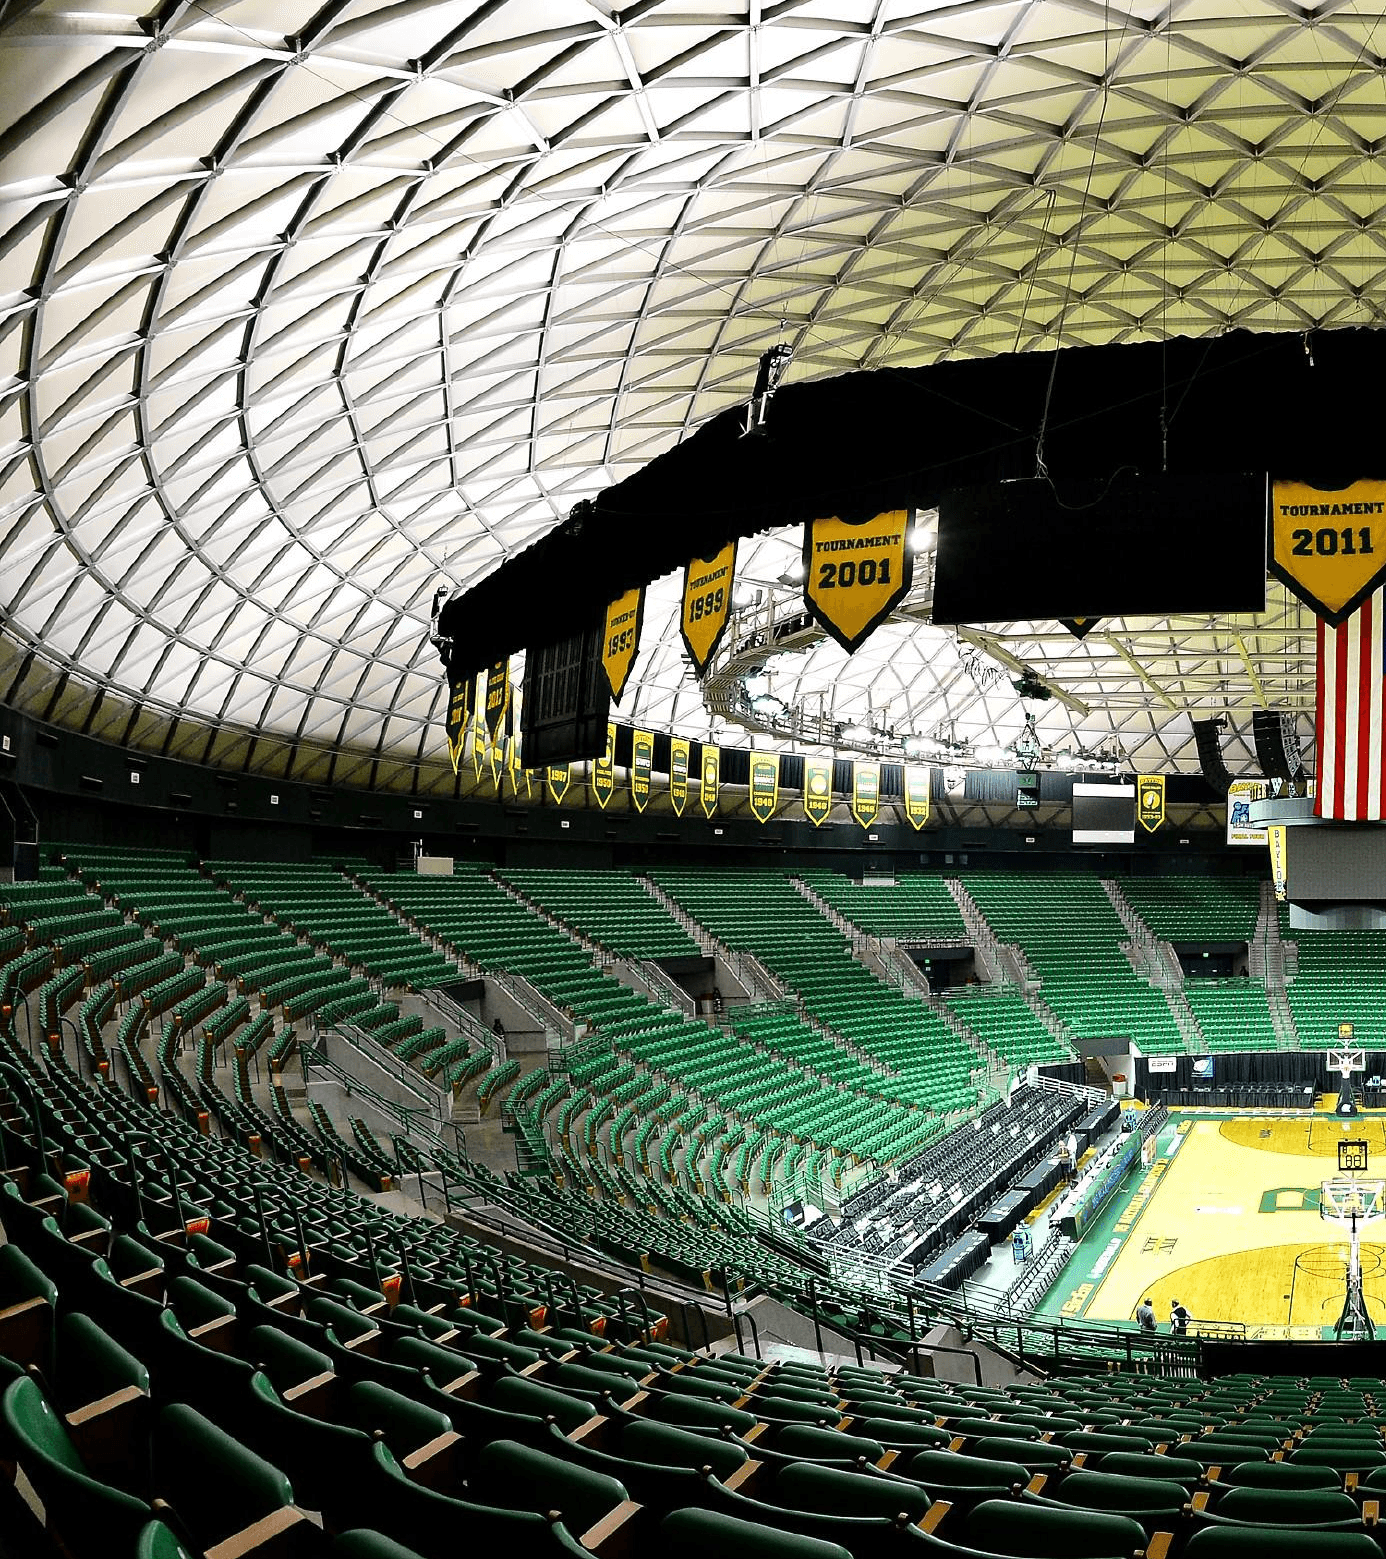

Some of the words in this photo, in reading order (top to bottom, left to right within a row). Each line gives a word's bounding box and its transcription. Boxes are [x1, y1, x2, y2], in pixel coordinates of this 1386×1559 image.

[1280, 502, 1384, 516] TOURNAMENT
[816, 534, 901, 552] TOURNAMENT
[1292, 527, 1373, 555] 2011
[818, 558, 891, 588] 2001
[689, 588, 724, 622] 1999
[1274, 829, 1284, 891] BAYLOR
